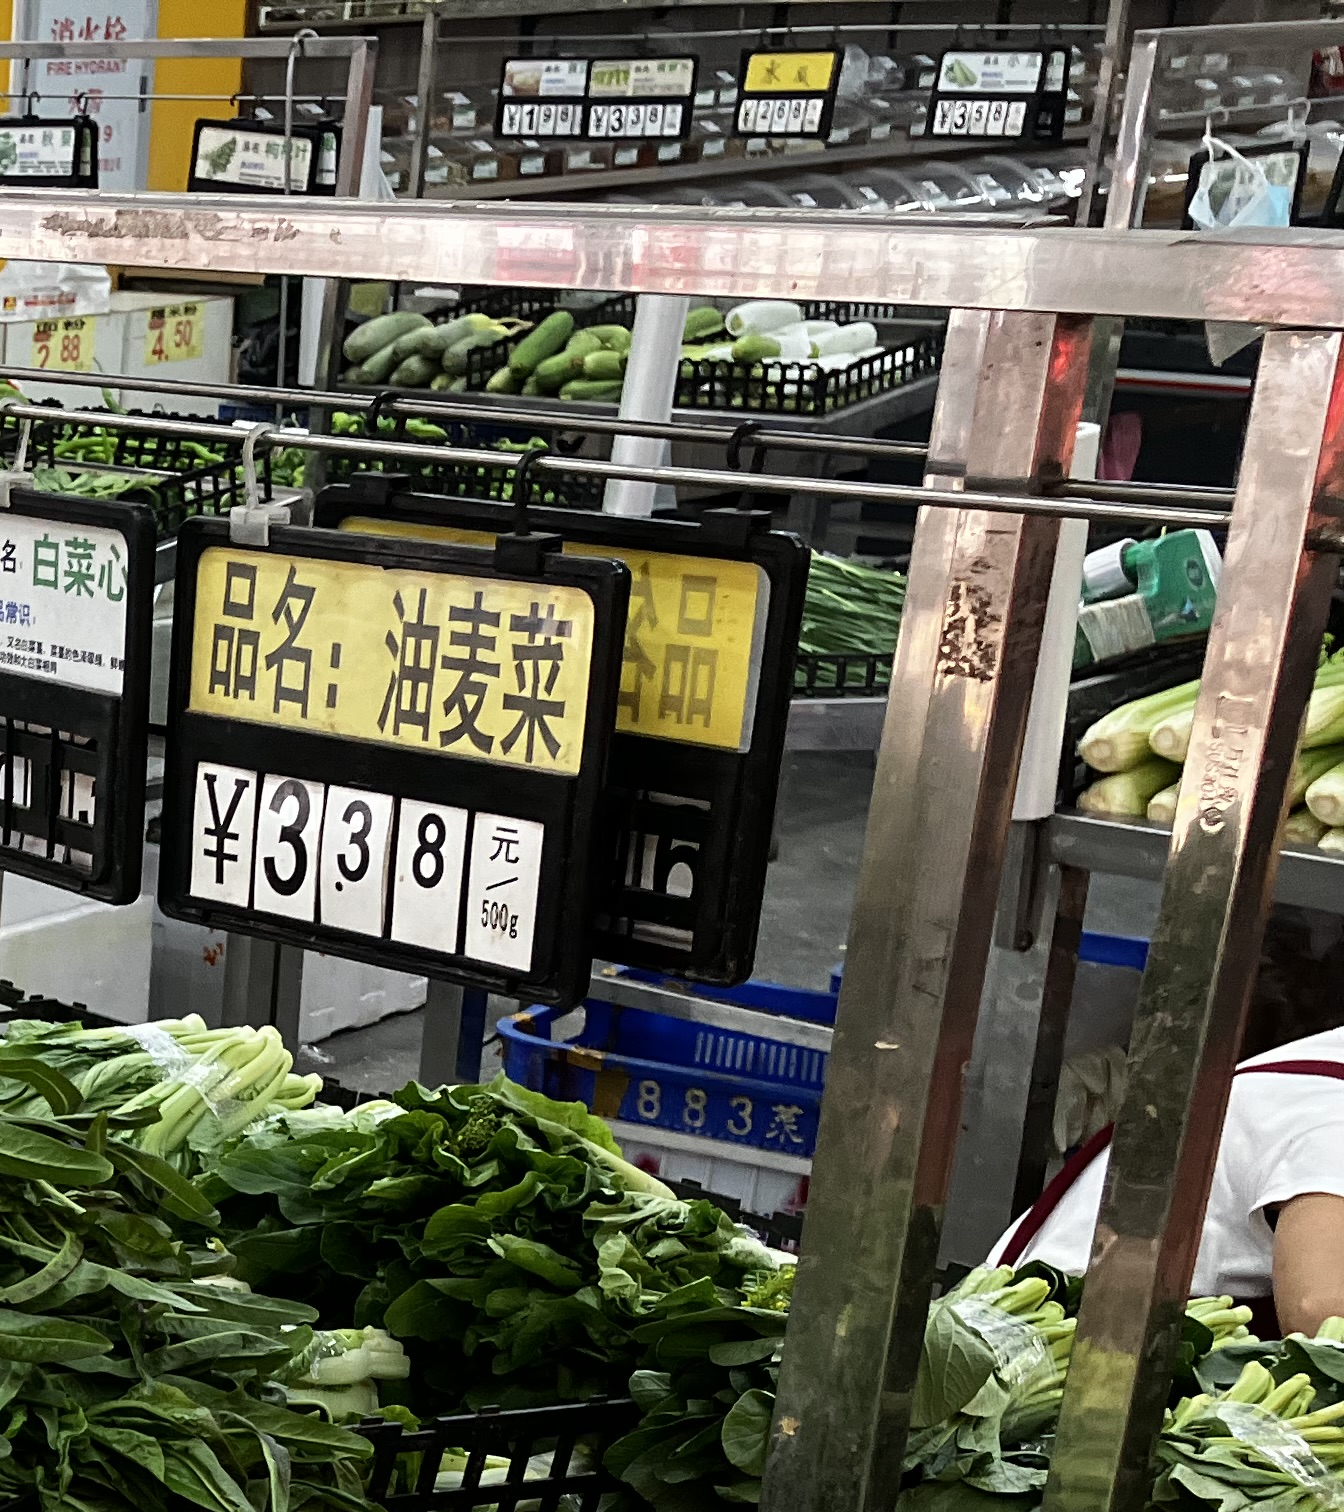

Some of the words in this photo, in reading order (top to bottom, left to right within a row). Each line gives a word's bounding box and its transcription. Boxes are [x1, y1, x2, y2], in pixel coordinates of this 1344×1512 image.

[32, 532, 128, 603] 白菜心
[376, 587, 573, 764] 油麦菜
